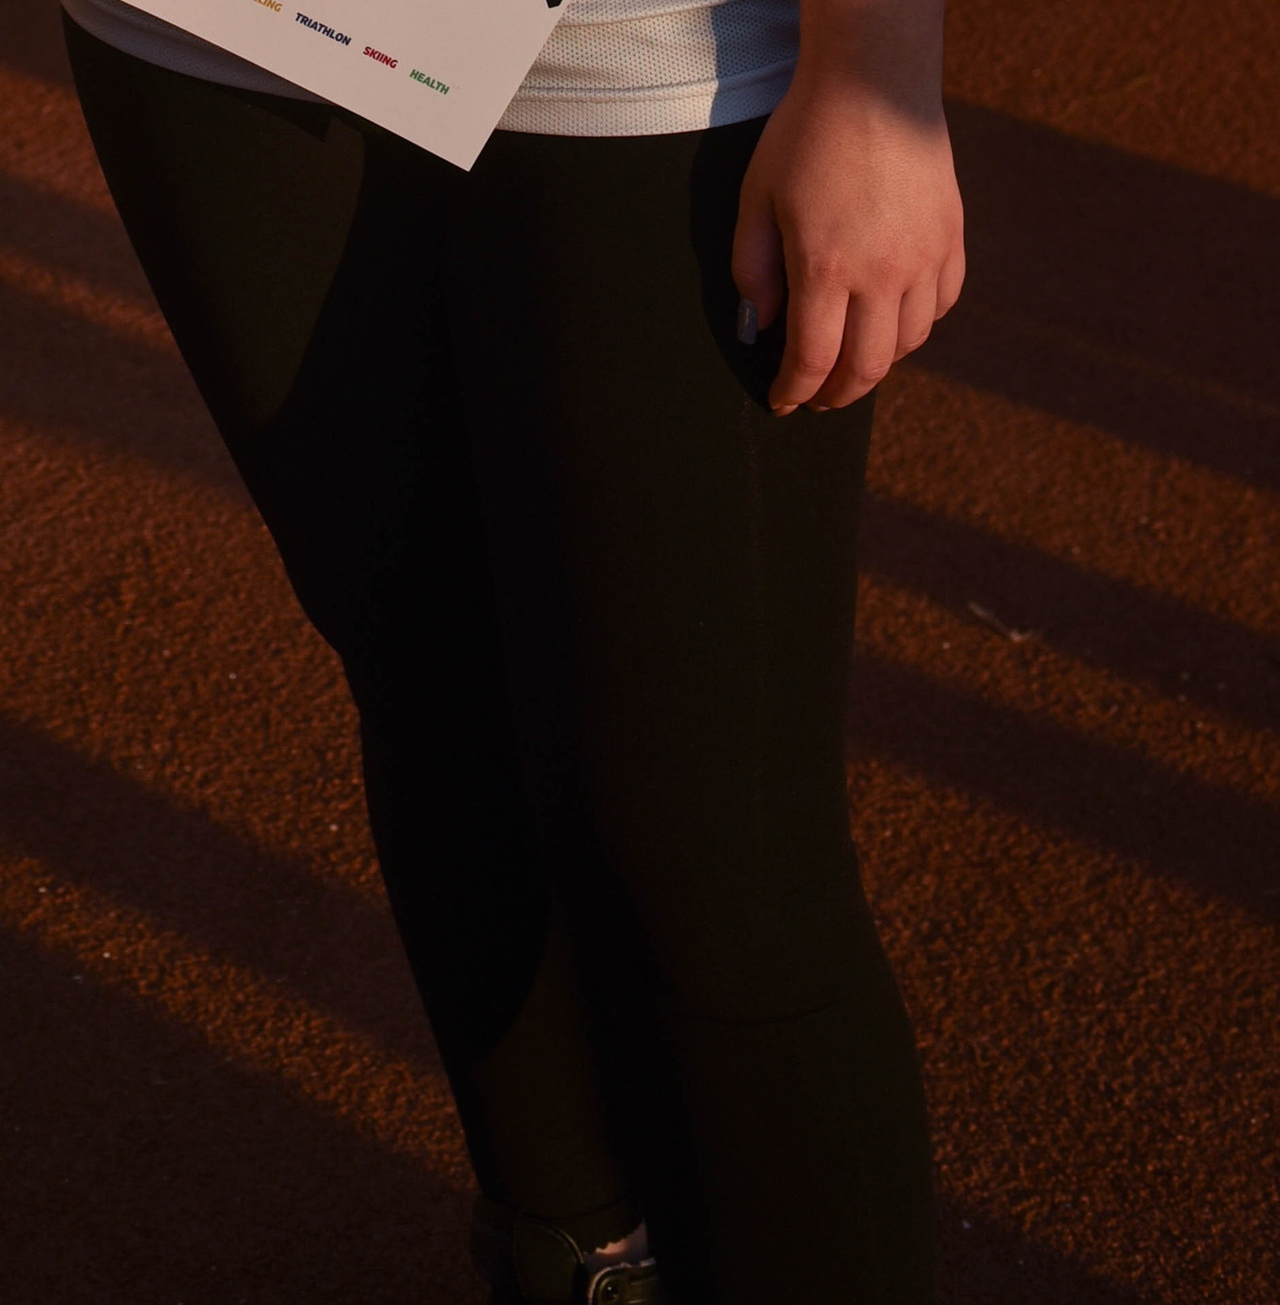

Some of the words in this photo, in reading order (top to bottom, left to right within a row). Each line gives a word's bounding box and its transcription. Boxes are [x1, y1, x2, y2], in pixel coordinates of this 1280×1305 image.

[295, 12, 352, 46] TRIATHLON
[362, 45, 398, 69] SKIING
[409, 68, 450, 95] HEALTH
